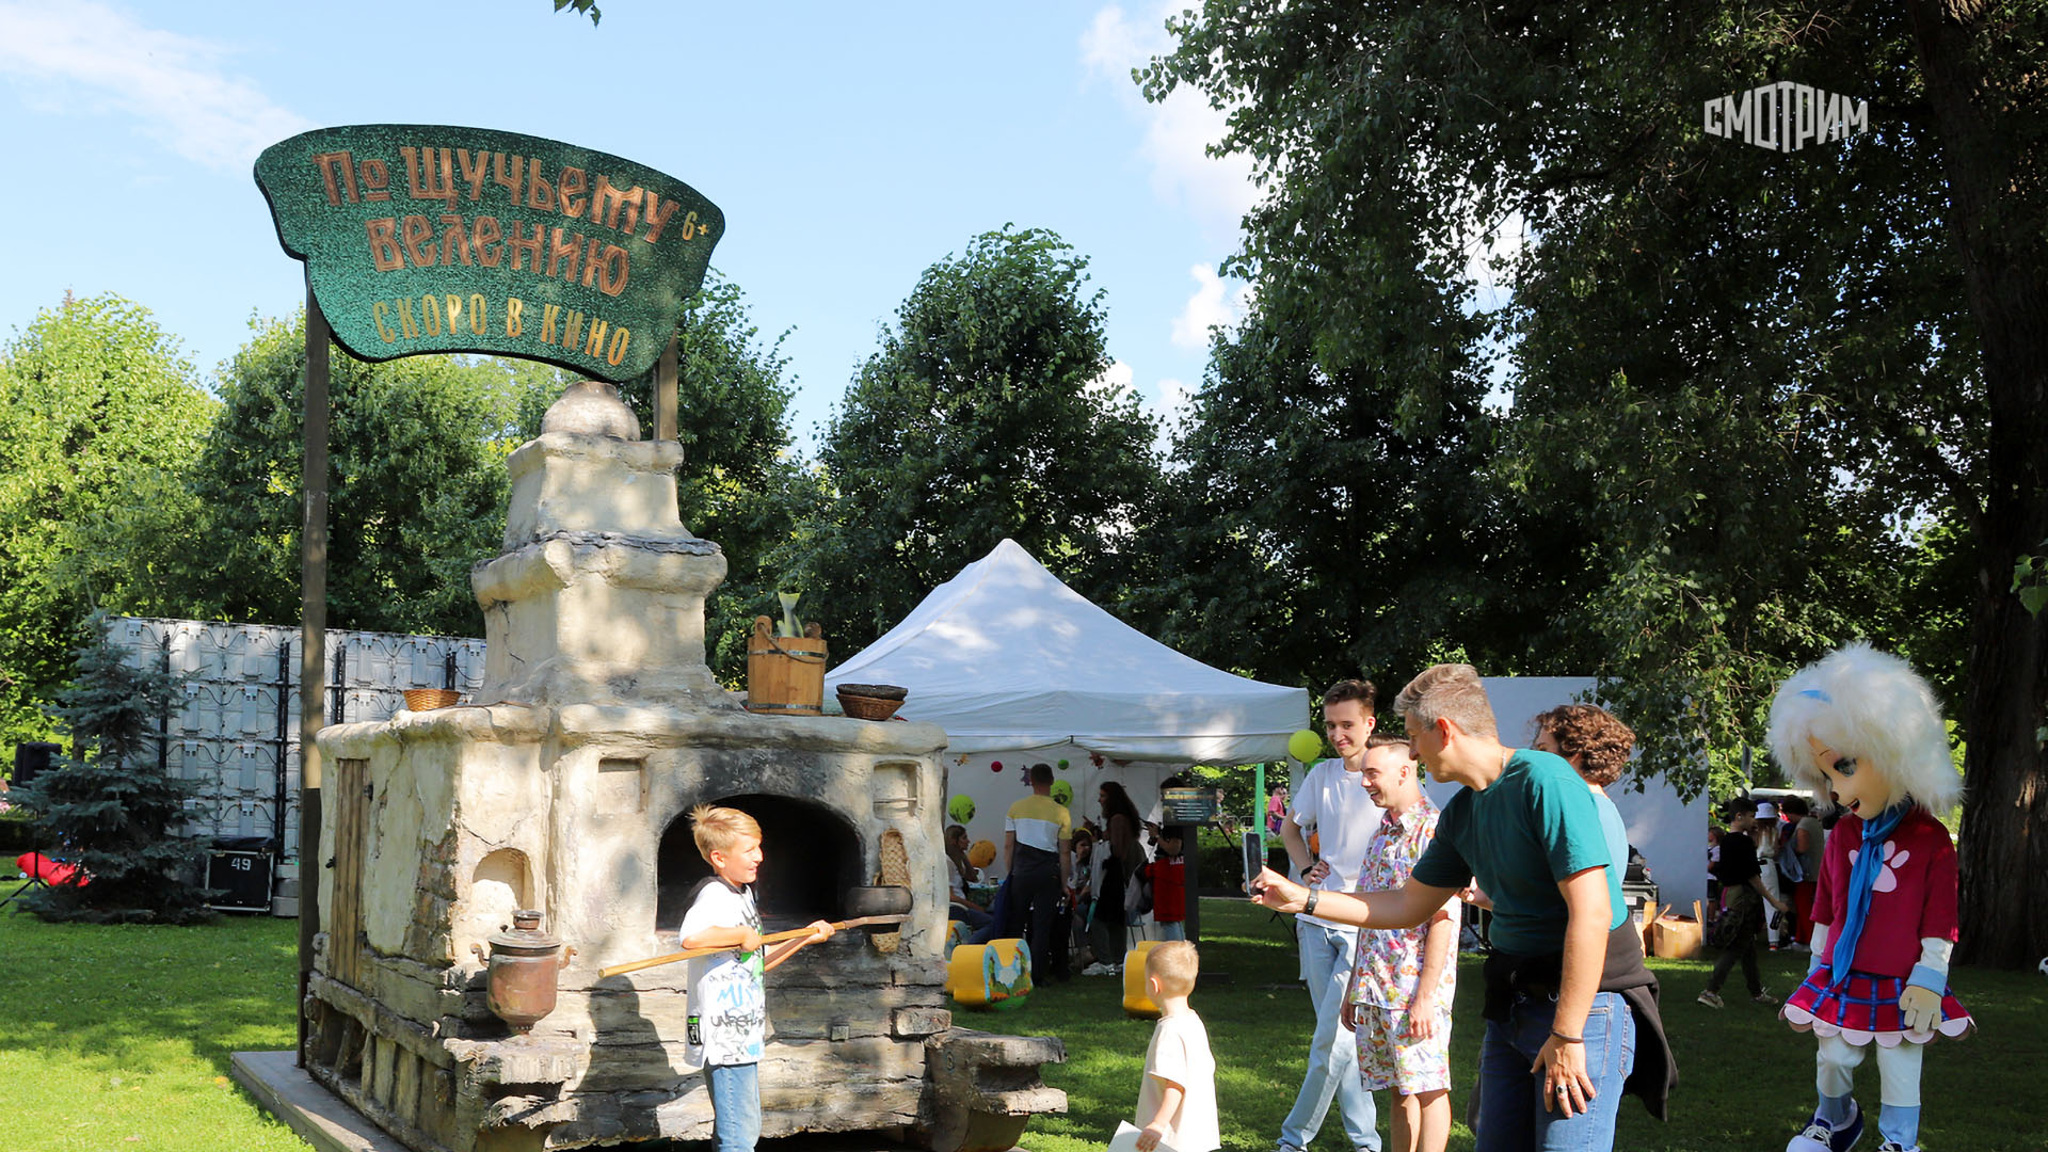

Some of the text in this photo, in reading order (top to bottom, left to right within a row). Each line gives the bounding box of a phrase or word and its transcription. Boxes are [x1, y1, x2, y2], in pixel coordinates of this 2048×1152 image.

[682, 210, 709, 241] 6+
[373, 293, 630, 366] СКОРО В КИНО
[231, 857, 251, 871] 49
